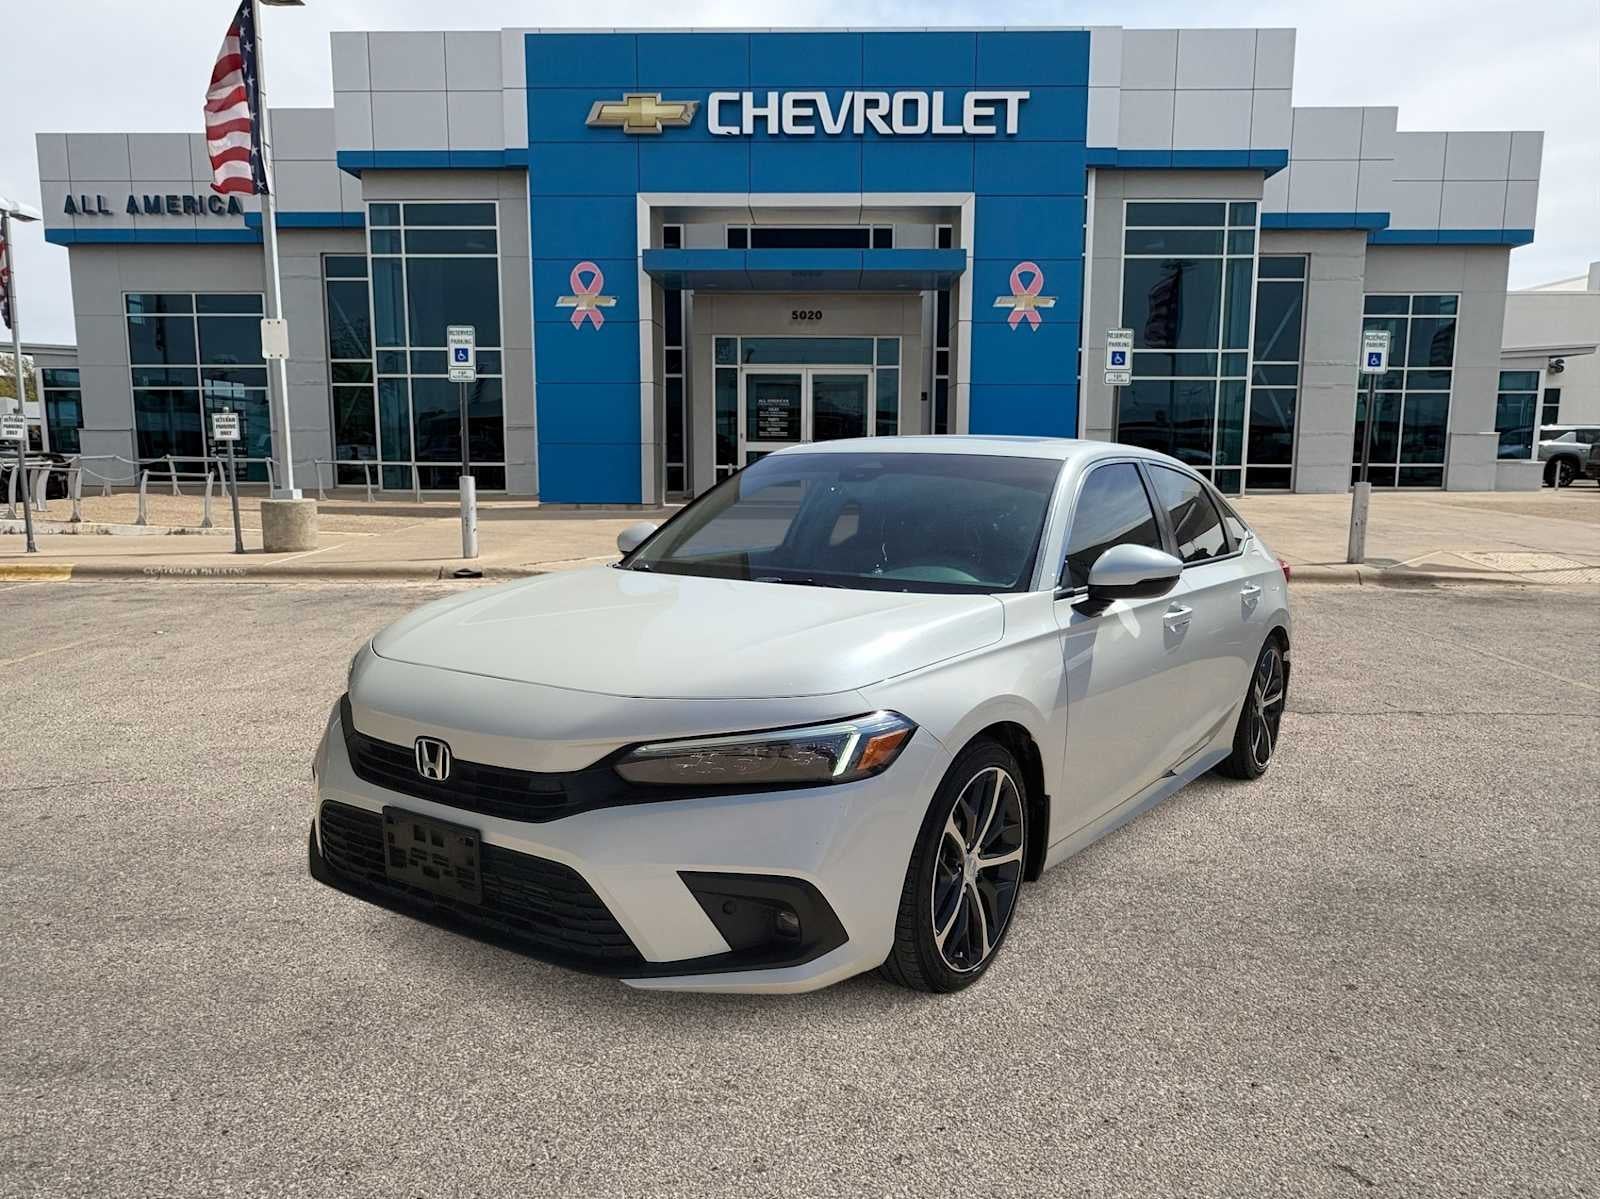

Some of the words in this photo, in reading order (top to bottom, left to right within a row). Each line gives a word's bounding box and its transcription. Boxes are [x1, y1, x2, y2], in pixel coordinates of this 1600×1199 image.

[707, 90, 1031, 136] CHEVROLET
[64, 194, 114, 216] ALL
[791, 310, 823, 320] 5020
